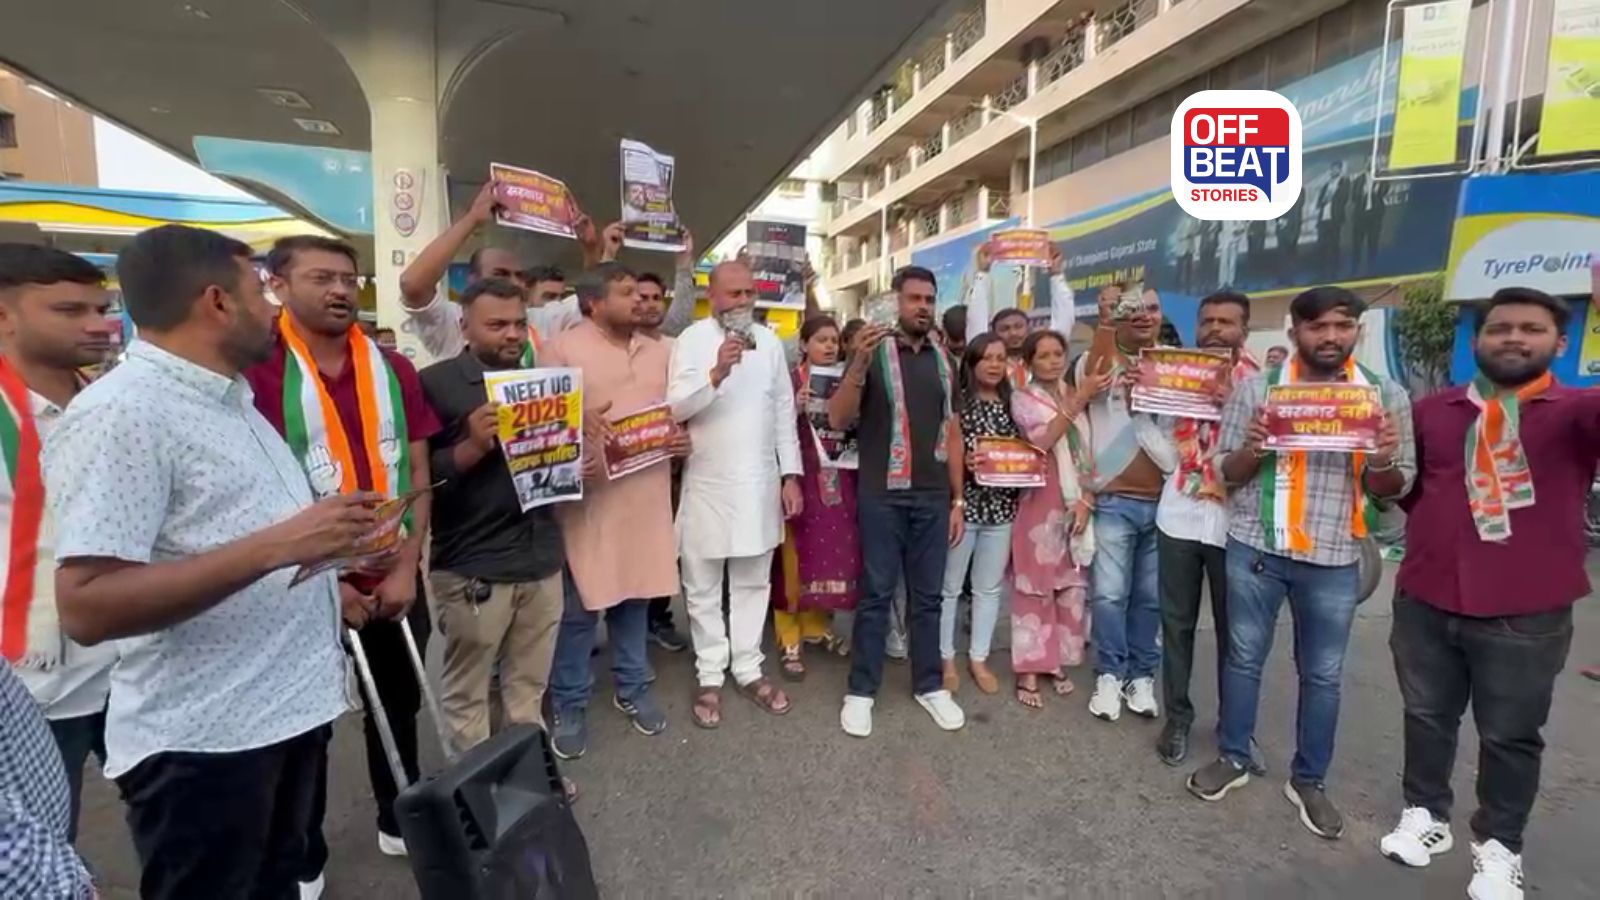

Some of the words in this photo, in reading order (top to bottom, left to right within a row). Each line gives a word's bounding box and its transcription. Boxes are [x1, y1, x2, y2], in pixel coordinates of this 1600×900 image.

[1137, 238, 1157, 250] State
[503, 379, 546, 404] NEET
[551, 375, 571, 395] UG
[512, 394, 567, 428] 2026
[1277, 404, 1336, 418] सरकार
